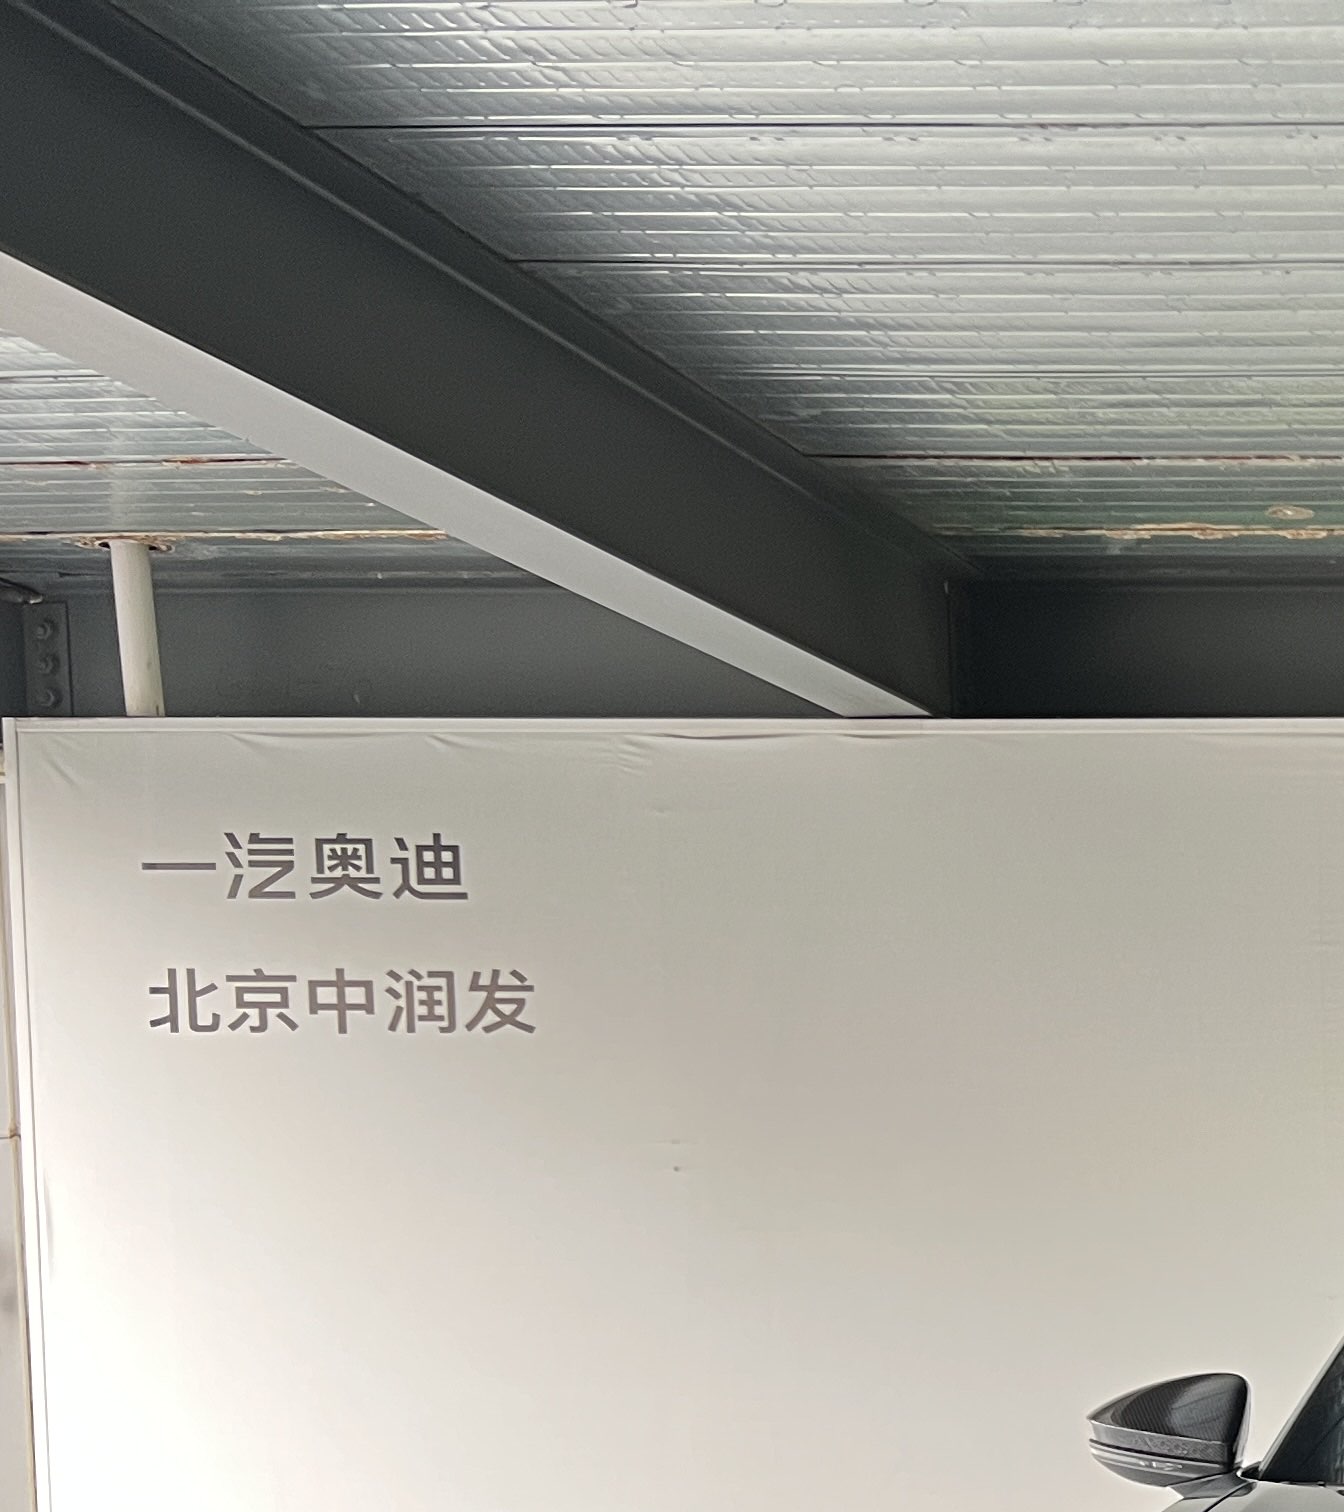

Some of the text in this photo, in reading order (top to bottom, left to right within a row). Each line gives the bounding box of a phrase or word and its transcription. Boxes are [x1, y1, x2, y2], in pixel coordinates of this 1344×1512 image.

[141, 832, 470, 901] 一汽奥迪
[148, 967, 538, 1036] 北京中润发
